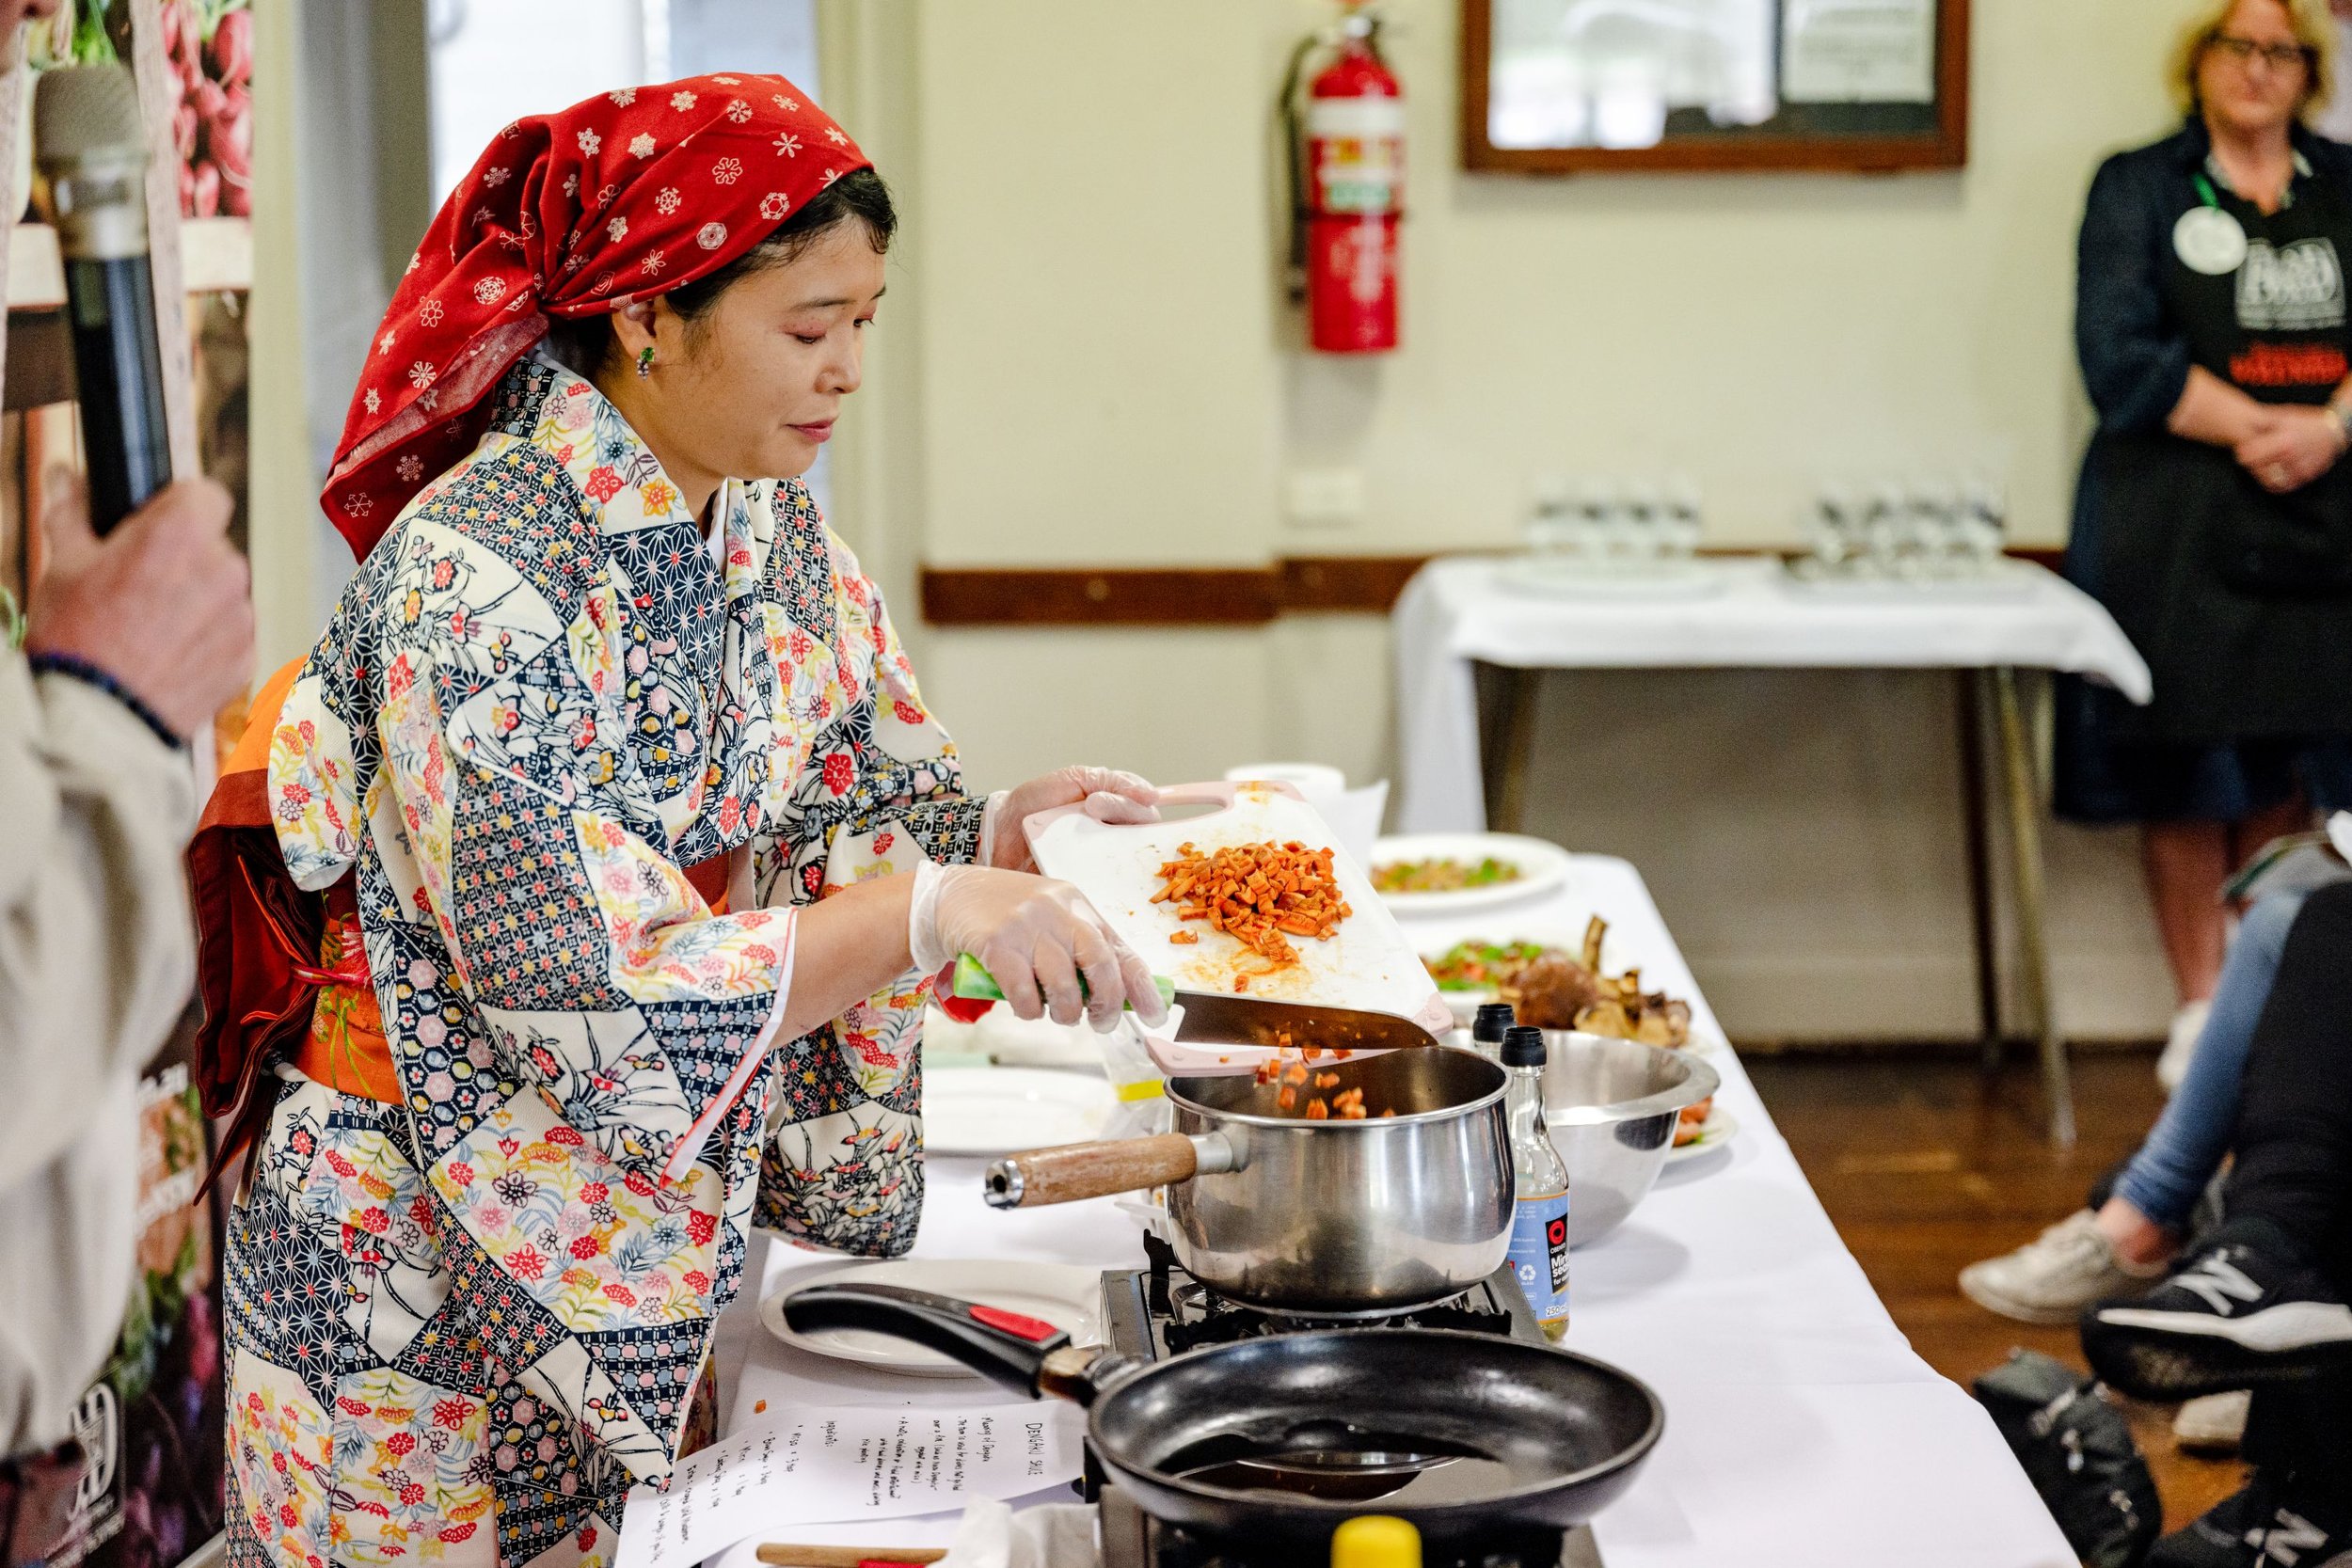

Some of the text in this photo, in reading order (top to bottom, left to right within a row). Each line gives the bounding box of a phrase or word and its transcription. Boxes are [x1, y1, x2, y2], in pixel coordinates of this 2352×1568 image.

[790, 1433, 802, 1446] Miso
[1025, 1423, 1044, 1475] DENGAKU SAUCE
